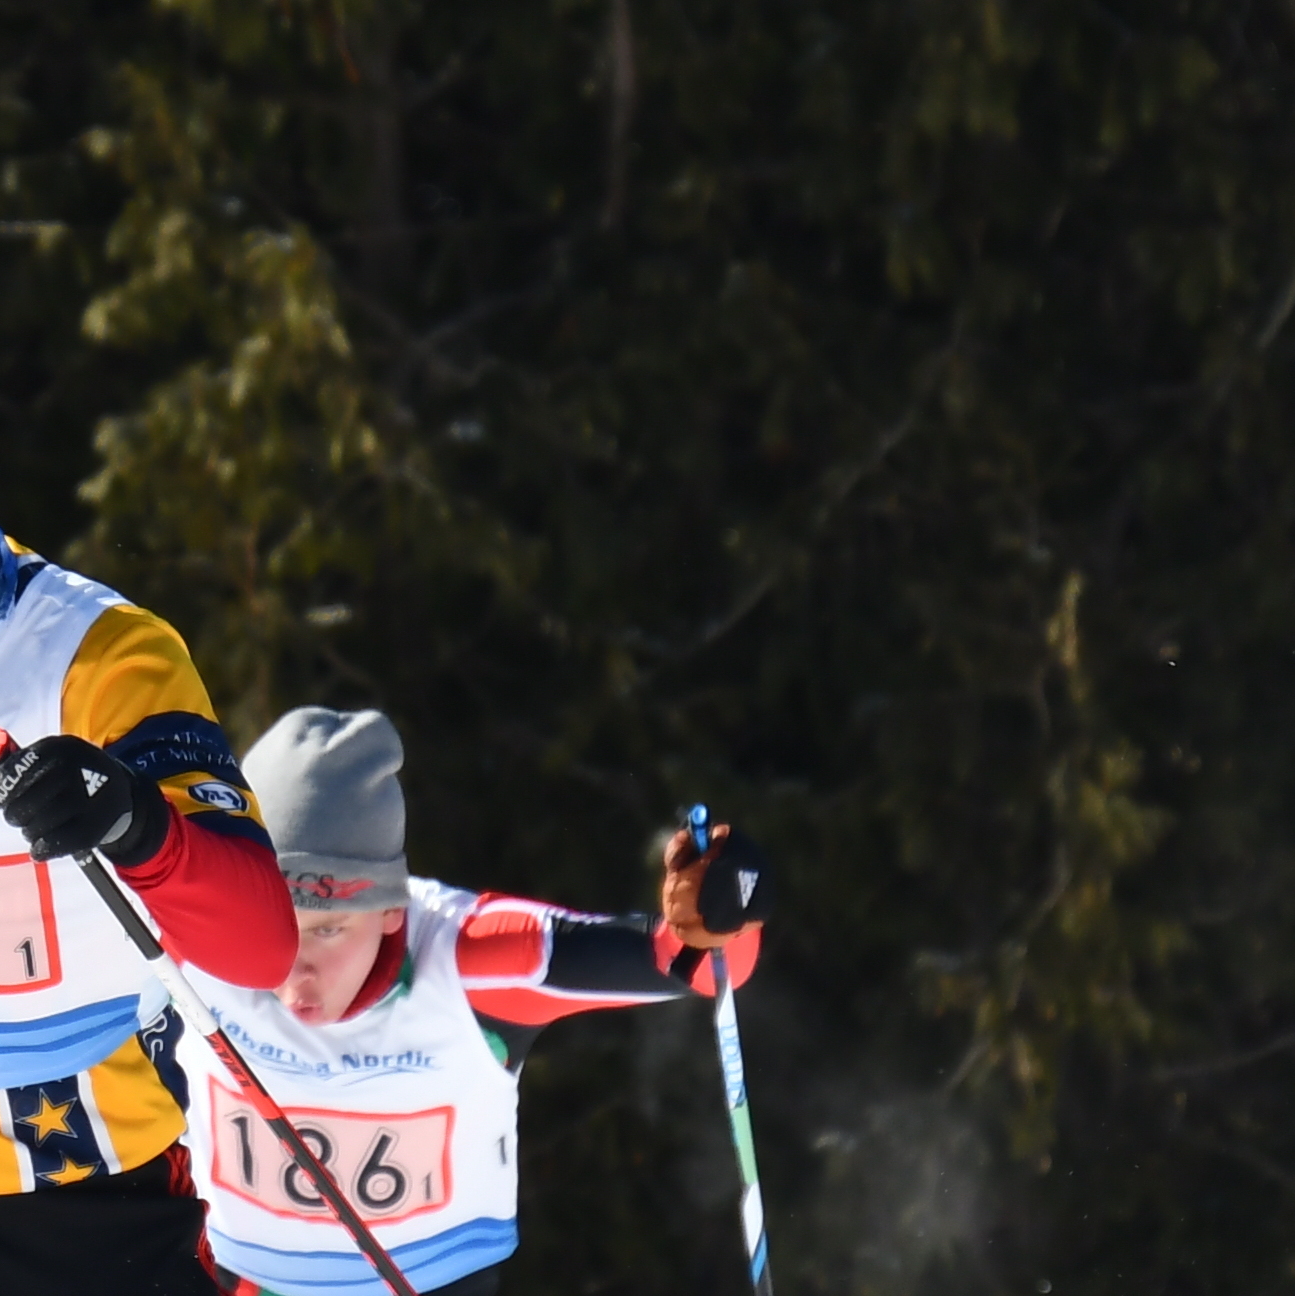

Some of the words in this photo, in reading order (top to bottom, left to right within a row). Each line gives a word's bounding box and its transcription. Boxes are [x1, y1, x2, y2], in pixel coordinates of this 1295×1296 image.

[15, 937, 37, 980] 1
[341, 1050, 435, 1069] Nordic
[225, 1108, 412, 1216] 186
